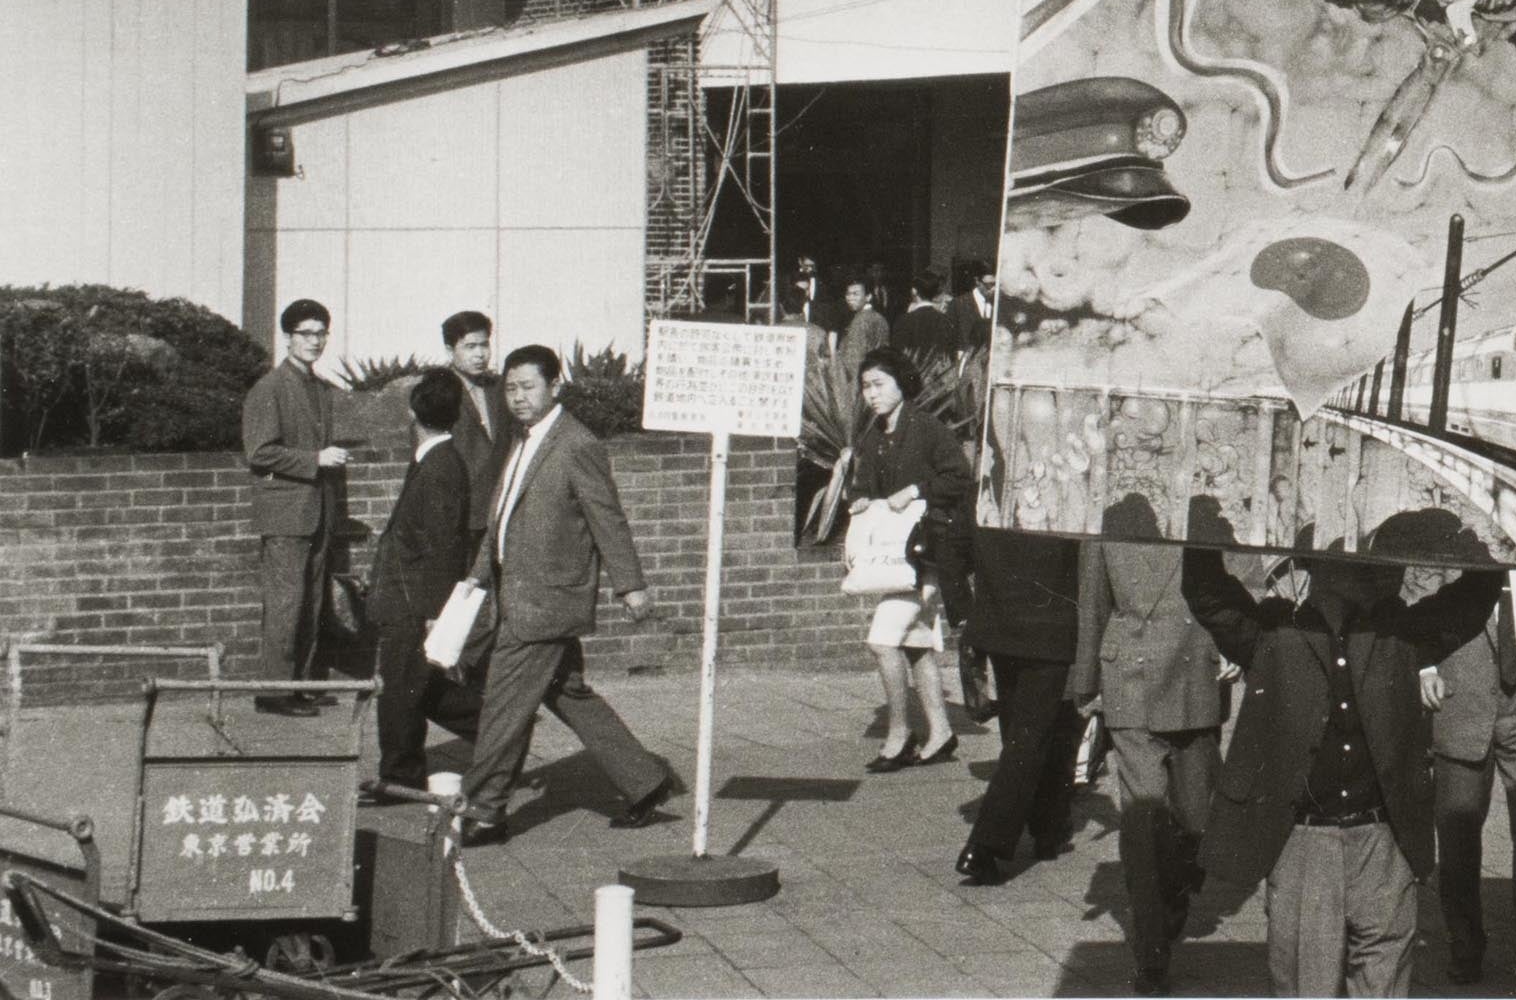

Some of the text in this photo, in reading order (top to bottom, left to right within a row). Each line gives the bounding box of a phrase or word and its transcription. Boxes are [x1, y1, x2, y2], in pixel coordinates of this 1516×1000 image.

[162, 792, 326, 825] 鉄道弘済会
[179, 831, 313, 858] 東京営業所
[248, 868, 296, 894] NO.4
